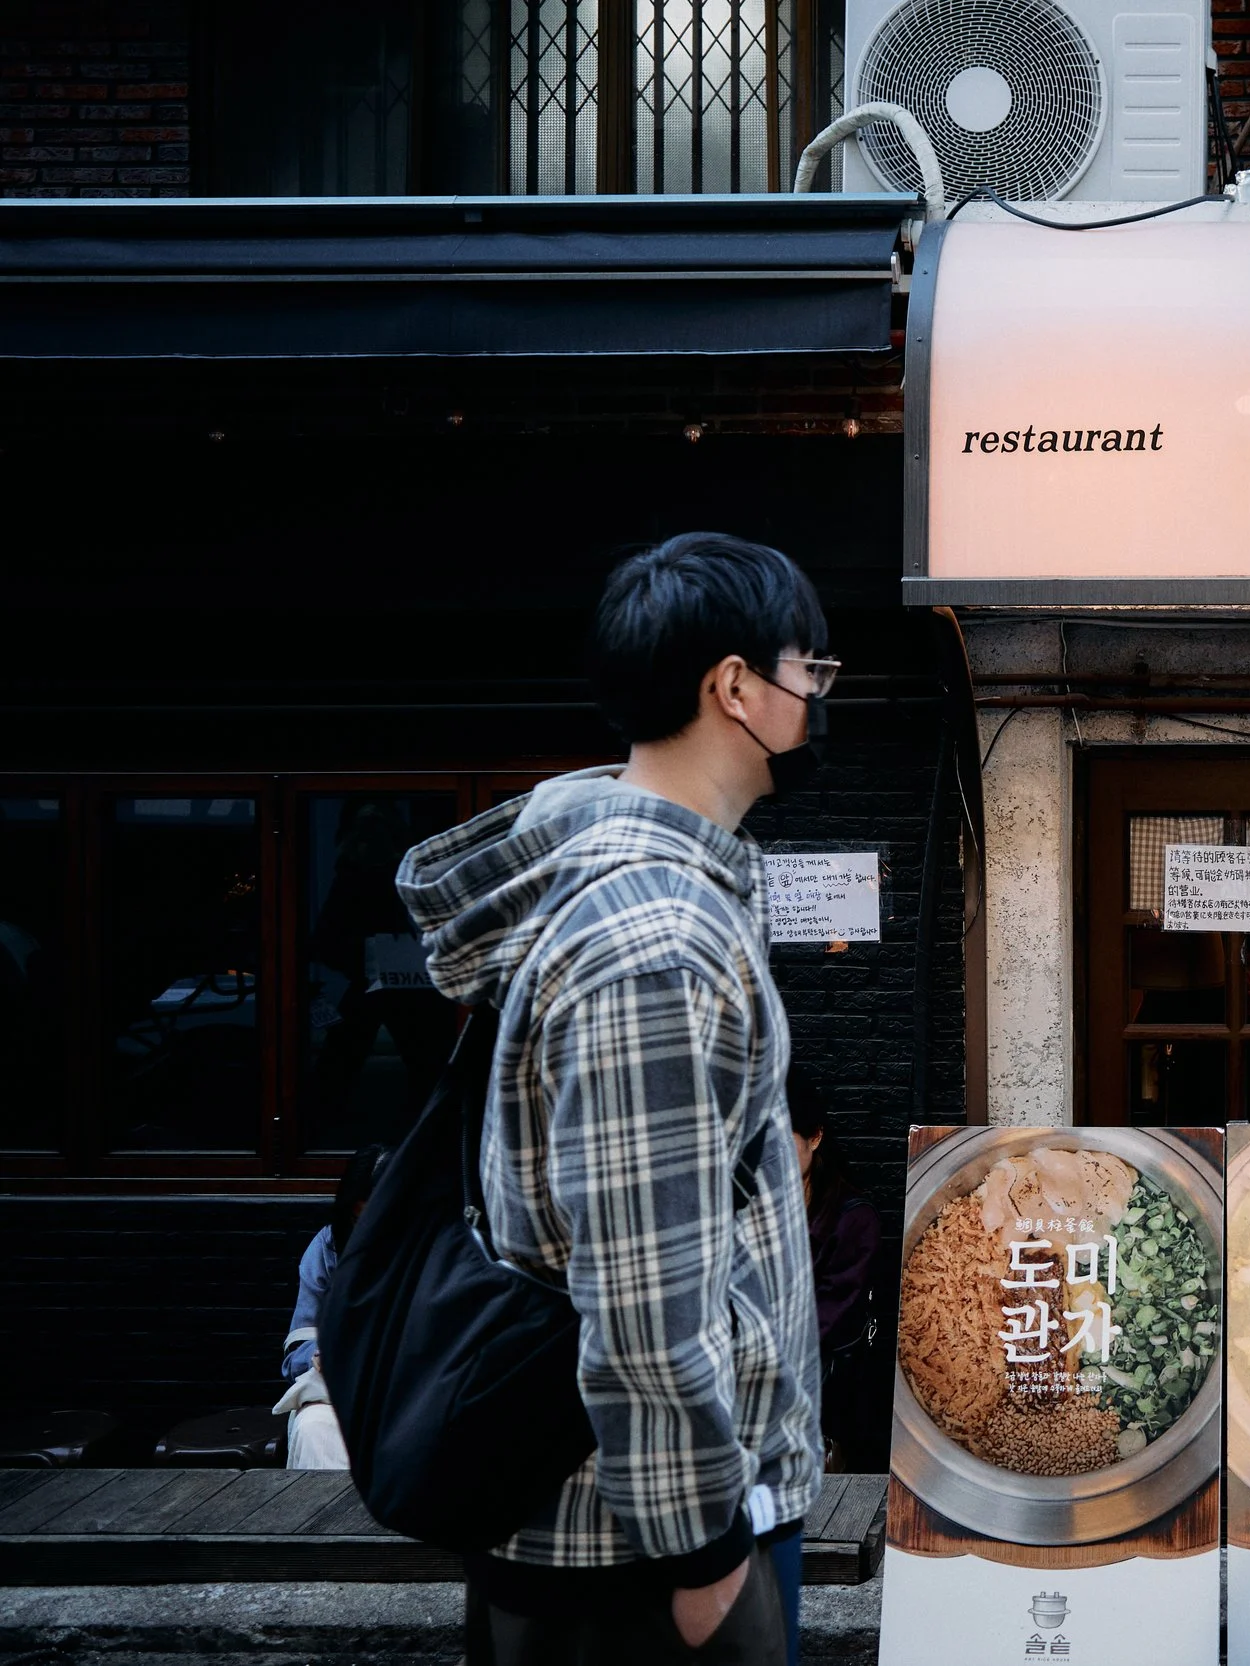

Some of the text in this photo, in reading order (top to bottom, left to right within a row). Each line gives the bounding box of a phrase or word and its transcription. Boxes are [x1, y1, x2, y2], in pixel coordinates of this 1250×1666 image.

[962, 422, 1164, 455] restaurant
[999, 1234, 1118, 1296] 도미
[998, 1299, 1122, 1363] 관자
[1025, 1632, 1071, 1655] 솔솥
